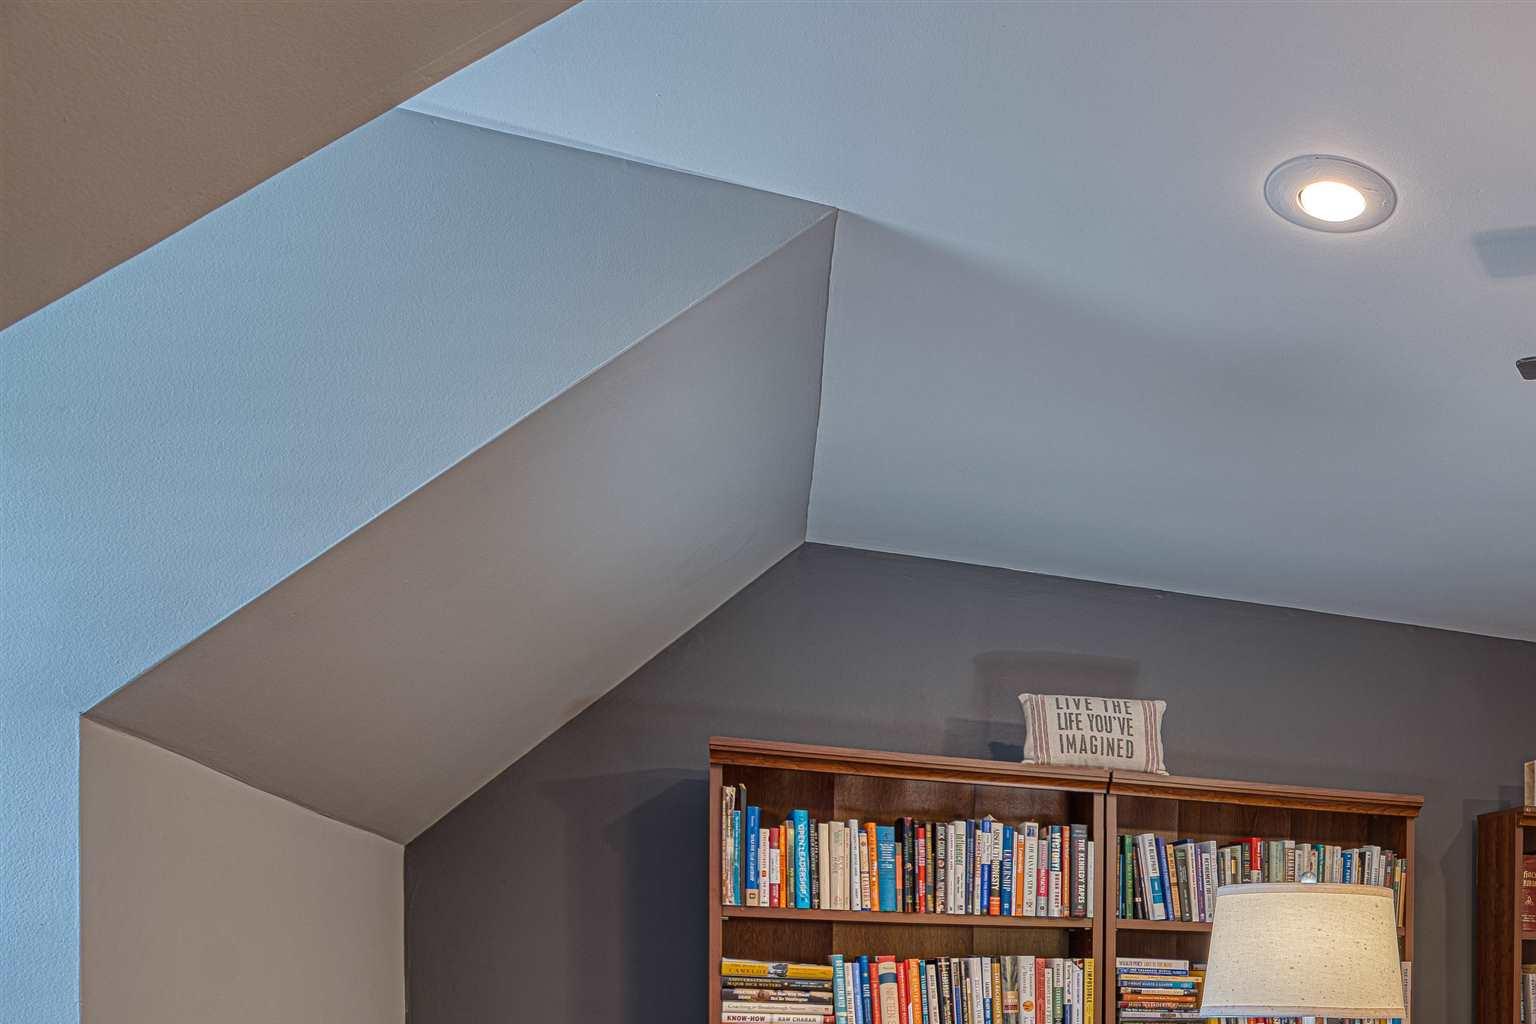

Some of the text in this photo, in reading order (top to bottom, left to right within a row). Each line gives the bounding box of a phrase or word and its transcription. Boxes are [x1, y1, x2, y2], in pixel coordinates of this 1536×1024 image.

[1056, 697, 1132, 715] LIVE THE
[1057, 712, 1133, 737] LIFE YOU'VE
[1060, 733, 1134, 759] IMAGINED
[1051, 833, 1061, 871] VICTORY!
[1149, 848, 1158, 875] BLUEPRINT
[1287, 849, 1295, 876] ABRAHAM
[798, 847, 808, 895] LEADERSHIP
[991, 860, 1001, 890] HONESTY
[1002, 849, 1012, 892] LEADERSHIP
[1078, 839, 1086, 904] THE KENNEDY TAPES
[1523, 870, 1536, 879] HOLY
[863, 984, 871, 997] ELITE
